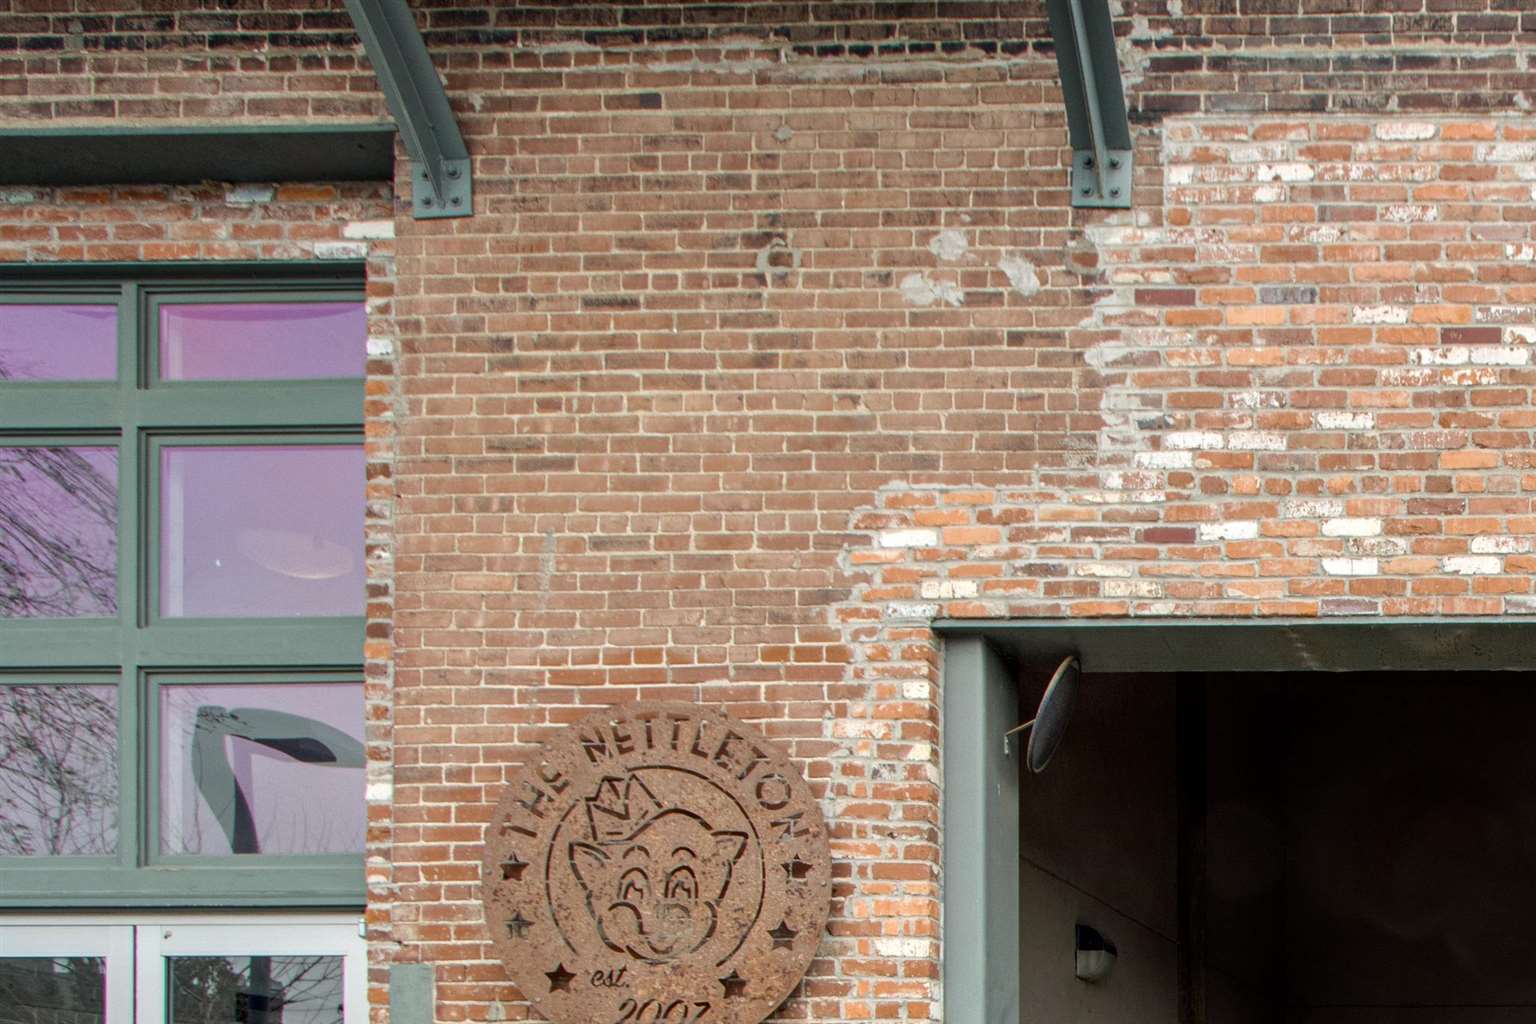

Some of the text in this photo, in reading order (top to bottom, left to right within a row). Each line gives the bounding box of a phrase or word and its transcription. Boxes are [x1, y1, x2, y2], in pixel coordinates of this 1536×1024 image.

[499, 711, 810, 844] THE NETTLETON
[591, 965, 630, 988] est.
